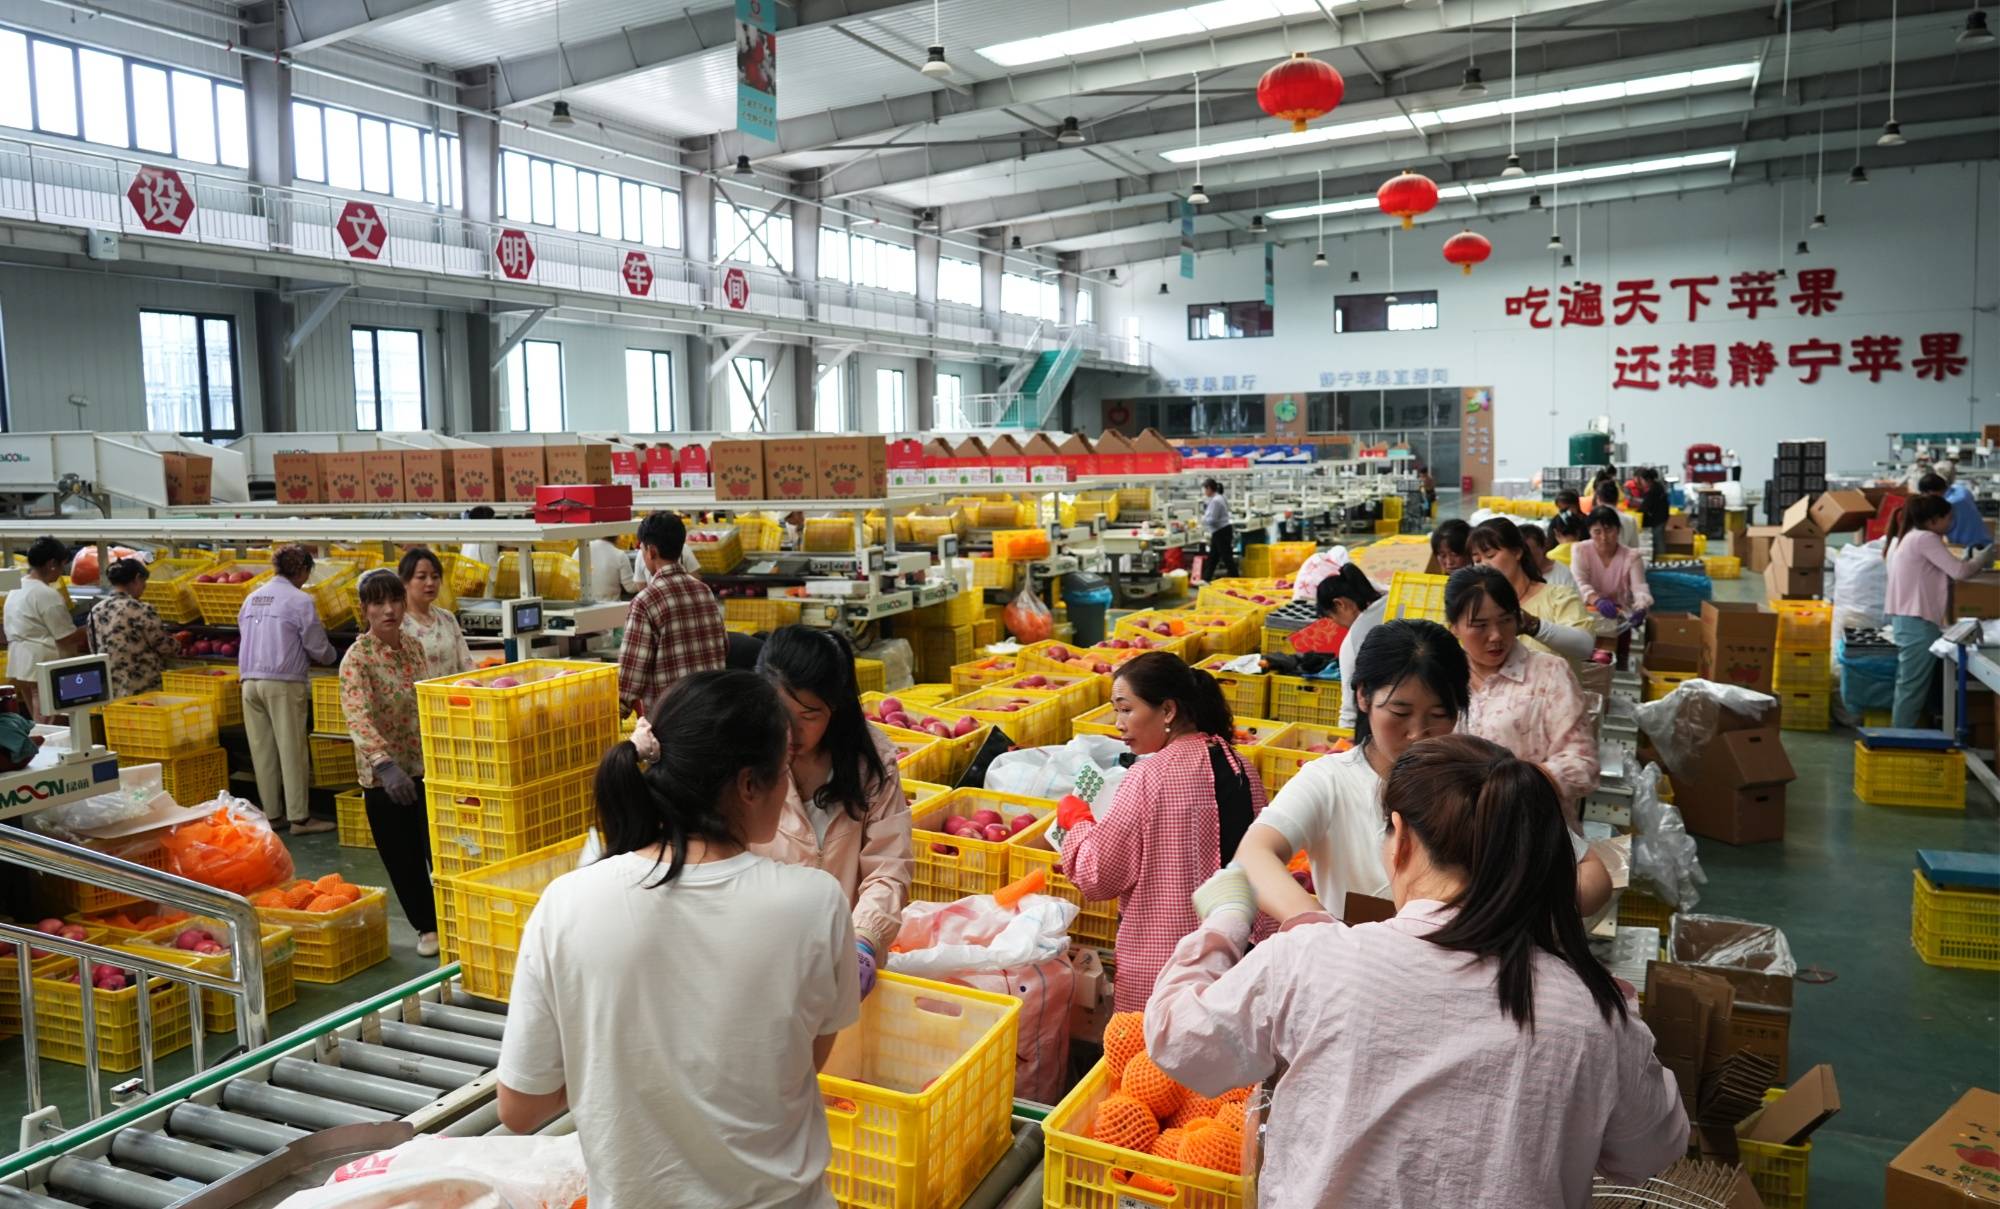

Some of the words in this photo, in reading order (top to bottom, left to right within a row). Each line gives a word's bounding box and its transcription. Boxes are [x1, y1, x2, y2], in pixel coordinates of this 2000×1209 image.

[139, 173, 185, 228] 设
[346, 208, 380, 256] 文
[501, 236, 531, 277] 明
[627, 257, 649, 293] 车
[728, 275, 746, 305] 间
[1505, 268, 1844, 329] 吃遍天下苹果
[1613, 333, 1968, 390] 还想静宁苹果
[75, 673, 84, 685] 6
